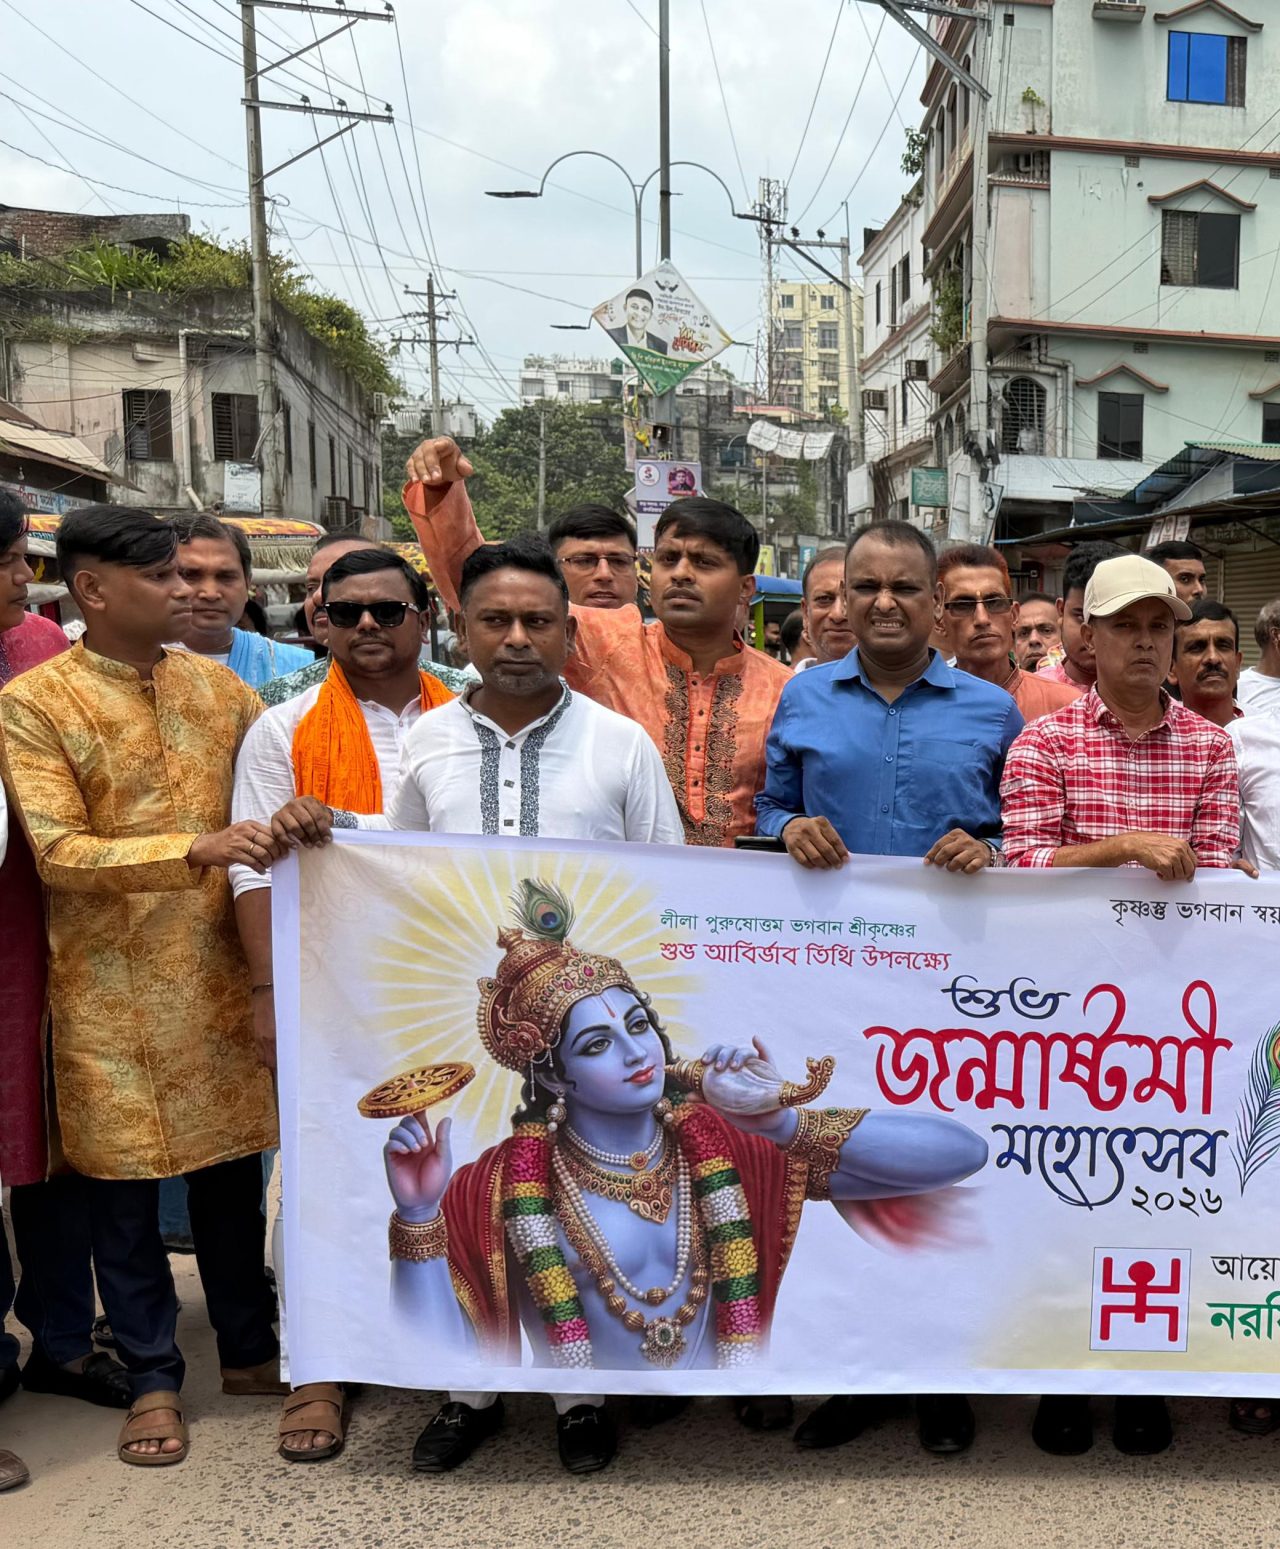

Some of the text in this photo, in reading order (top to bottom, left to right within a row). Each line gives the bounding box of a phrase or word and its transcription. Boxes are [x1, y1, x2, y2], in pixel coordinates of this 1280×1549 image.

[660, 909, 916, 943] লীলা পুরুষোত্তম ভগবান শ্রীকৃষ্ণের
[1176, 902, 1245, 923] ভগবান
[660, 942, 697, 960] শুভ
[703, 940, 800, 966] আবির্ভাব
[805, 943, 855, 967] তিথি
[941, 975, 1071, 1020] শুভ
[862, 980, 1233, 1115] জন্মাষ্টমী
[991, 1123, 1229, 1210] মহোৎসব
[1131, 1186, 1223, 1216] ২০২৬
